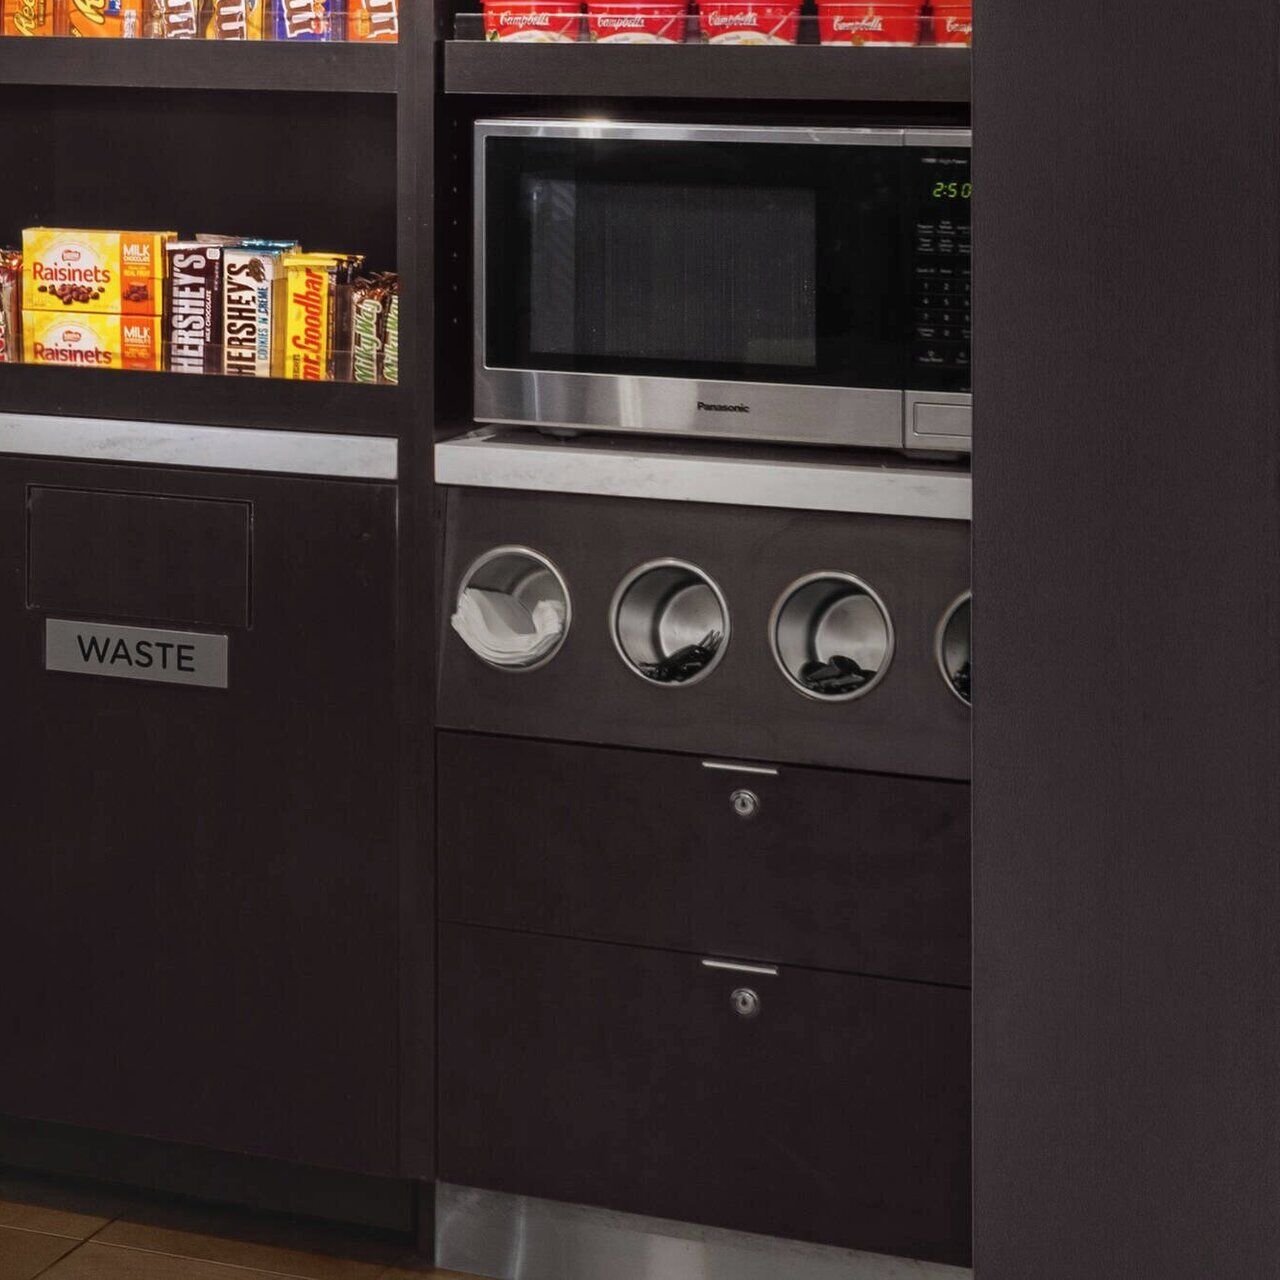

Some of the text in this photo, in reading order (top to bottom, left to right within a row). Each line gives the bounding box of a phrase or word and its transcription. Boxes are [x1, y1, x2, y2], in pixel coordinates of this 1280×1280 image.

[933, 182, 972, 198] 2:50
[123, 244, 150, 256] MILK
[33, 262, 110, 283] Raisinets
[171, 254, 206, 374] HERSHEY'S
[227, 262, 257, 377] HERSHEY'S
[124, 326, 150, 338] MILK
[33, 342, 112, 364] Raisinets
[697, 402, 749, 414] Panasonic
[77, 634, 195, 672] WASTE
